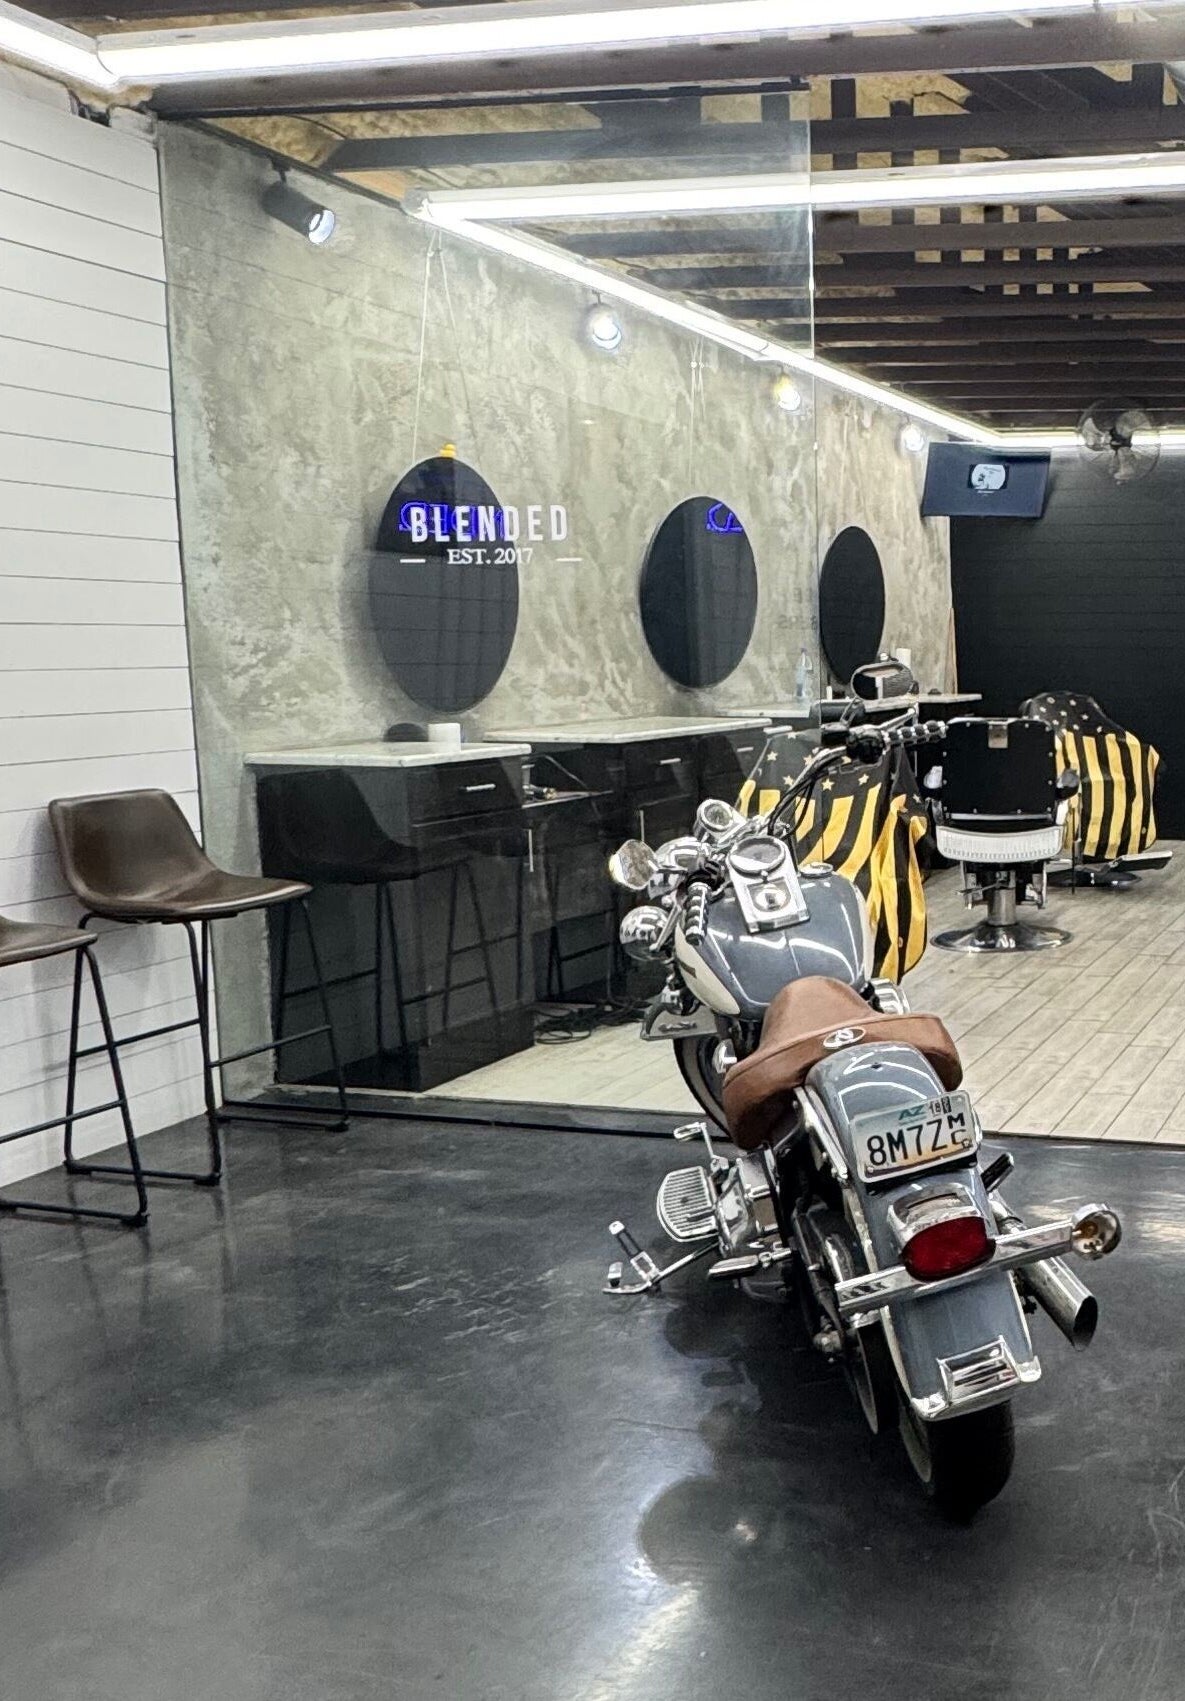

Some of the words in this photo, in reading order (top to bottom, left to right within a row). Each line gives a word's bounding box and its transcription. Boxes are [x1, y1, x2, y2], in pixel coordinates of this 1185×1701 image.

[410, 504, 568, 543] BLENDED
[447, 548, 491, 565] EST.
[494, 547, 534, 565] 2017
[898, 1104, 927, 1121] AZ
[867, 1118, 948, 1166] 8M7Z
